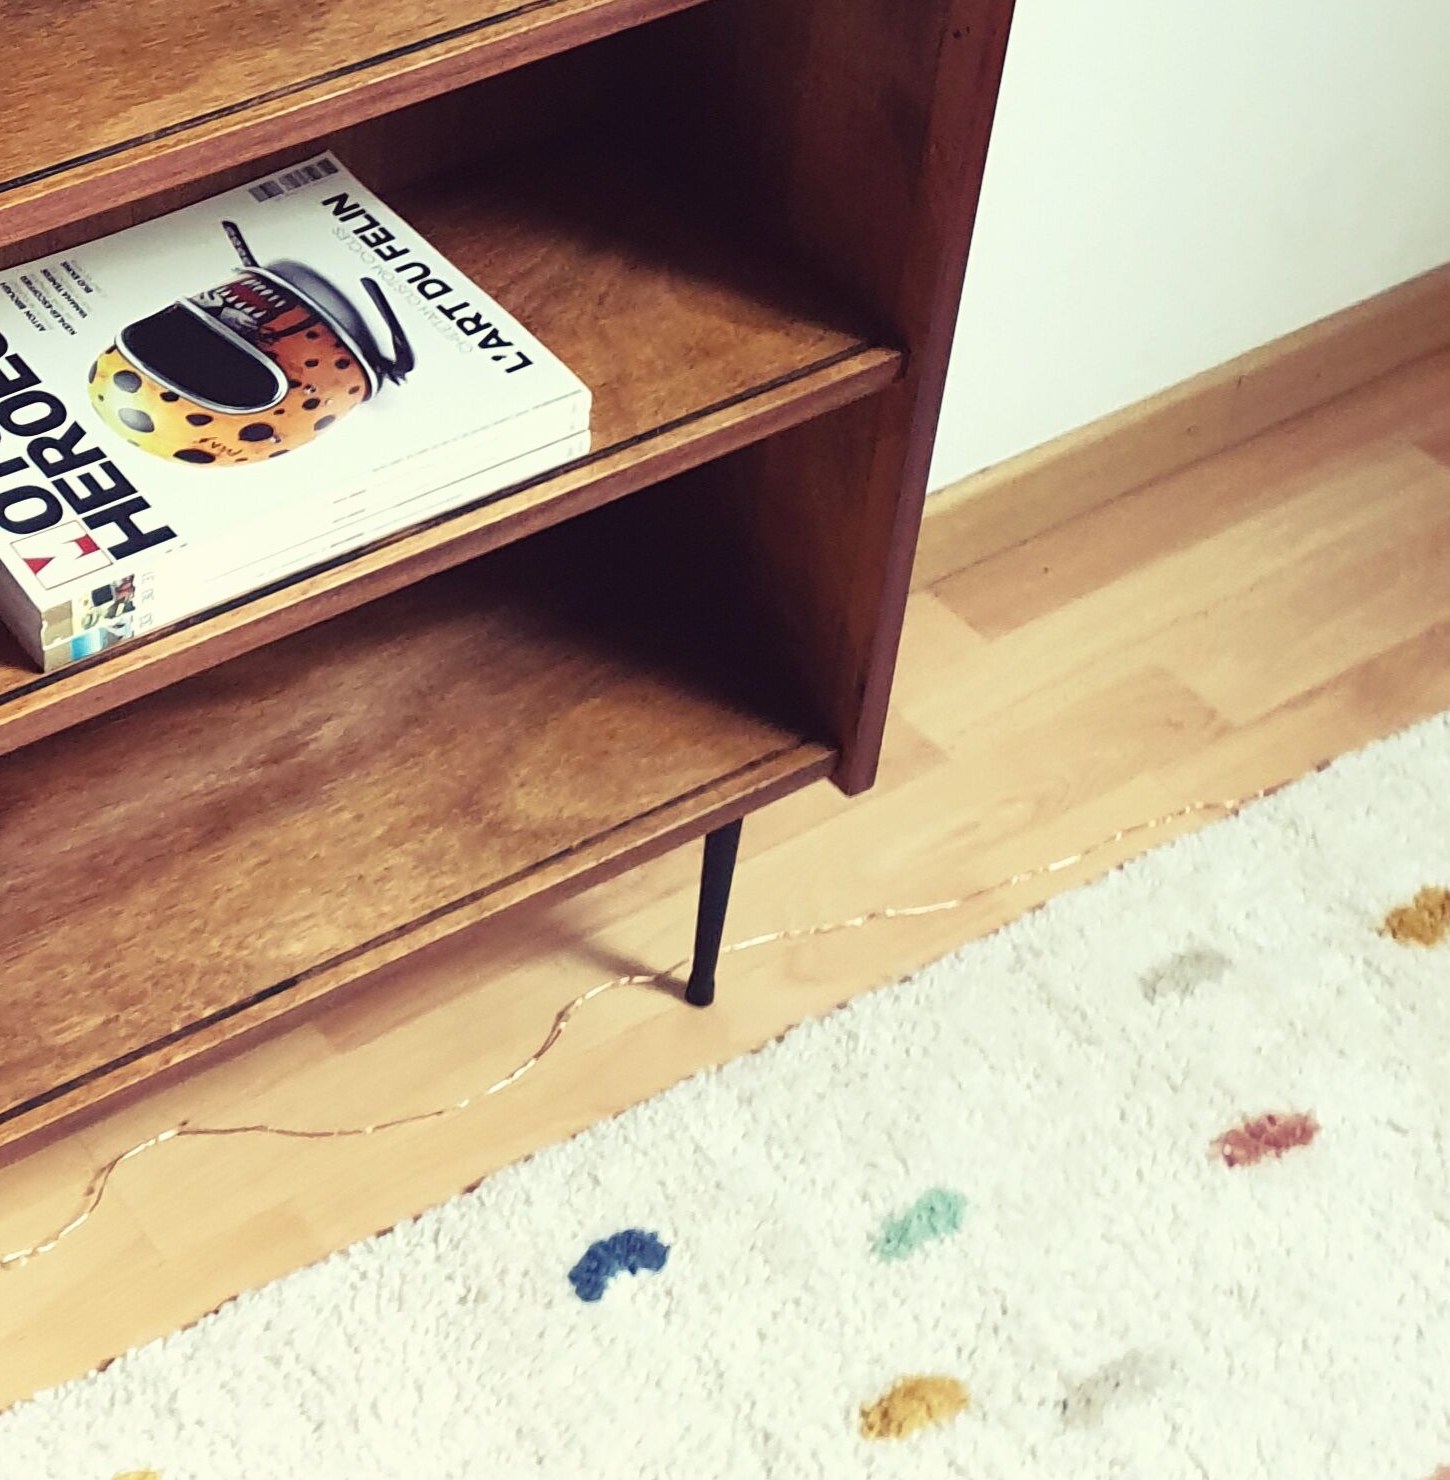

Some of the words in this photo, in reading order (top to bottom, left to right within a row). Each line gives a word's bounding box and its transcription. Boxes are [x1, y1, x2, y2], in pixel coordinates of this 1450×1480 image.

[322, 193, 409, 261] FELIN
[395, 262, 453, 299] DU
[437, 302, 533, 373] L'ART
